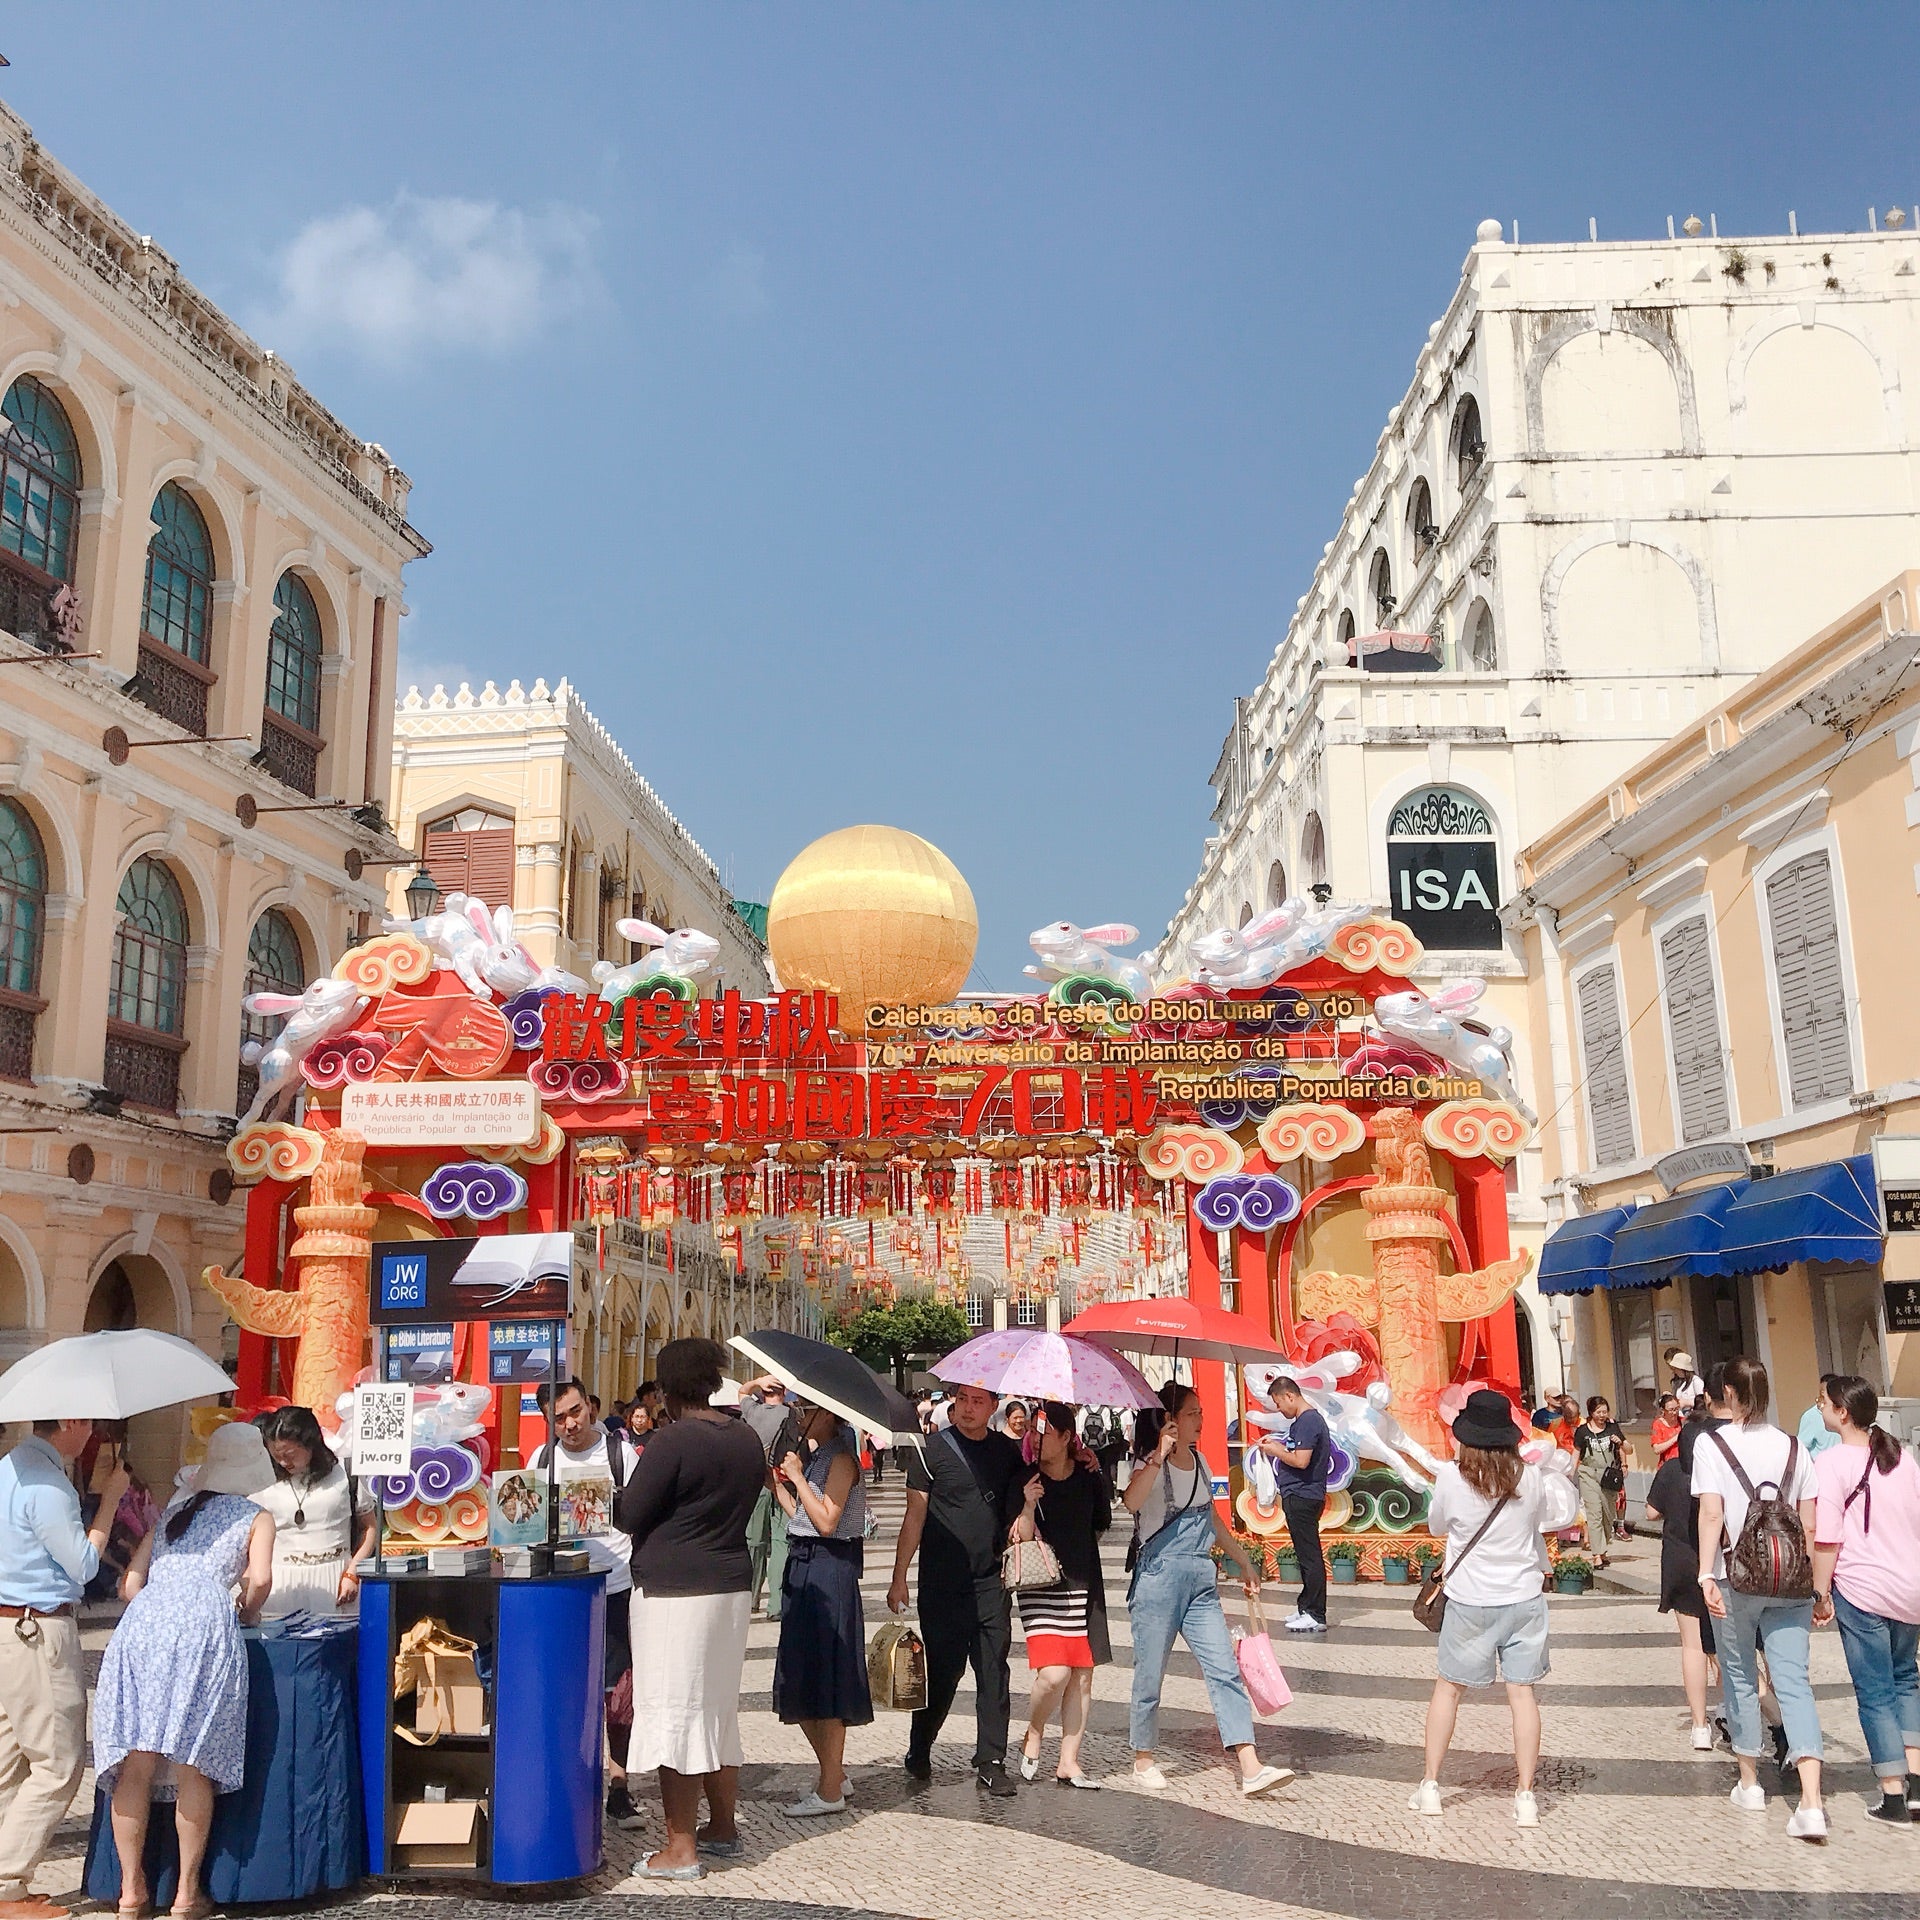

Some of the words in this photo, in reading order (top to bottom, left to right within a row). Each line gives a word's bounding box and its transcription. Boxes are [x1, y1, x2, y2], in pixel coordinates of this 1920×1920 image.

[1400, 869, 1494, 911] ISA
[867, 1004, 998, 1030] Celebração
[1008, 1004, 1035, 1025] da
[1043, 1002, 1107, 1025] Festa
[1117, 1000, 1144, 1022] do
[1150, 999, 1202, 1022] Bolo
[1208, 997, 1276, 1021] Lunar
[1295, 1003, 1311, 1018] e
[1322, 996, 1353, 1018] do
[542, 989, 840, 1061] 歡度中秋
[925, 1041, 1054, 1064] Aniversário
[1064, 1040, 1093, 1063] da
[1101, 1038, 1242, 1064] Implantação
[1255, 1037, 1285, 1059] da
[1160, 1077, 1277, 1100] República
[1282, 1076, 1375, 1102] Popular
[1378, 1076, 1408, 1097] da
[1411, 1075, 1482, 1098] China
[351, 1092, 527, 1108] 中華人民共和國成立70周年
[643, 1065, 1158, 1142] 喜迎國慶70載
[371, 1112, 425, 1122] Aniversário
[432, 1112, 445, 1122] da
[452, 1111, 511, 1123] Implantação
[517, 1111, 530, 1121] da
[419, 1124, 457, 1136] Popular
[464, 1123, 476, 1134] da
[484, 1123, 512, 1134] China
[390, 1264, 419, 1284] JW
[387, 1286, 418, 1301] .ORG
[398, 1329, 417, 1347] Bible
[417, 1328, 451, 1346] Literature
[493, 1324, 562, 1344] 免费圣经书
[497, 1359, 509, 1367] JW
[360, 1450, 402, 1464] jw.org
